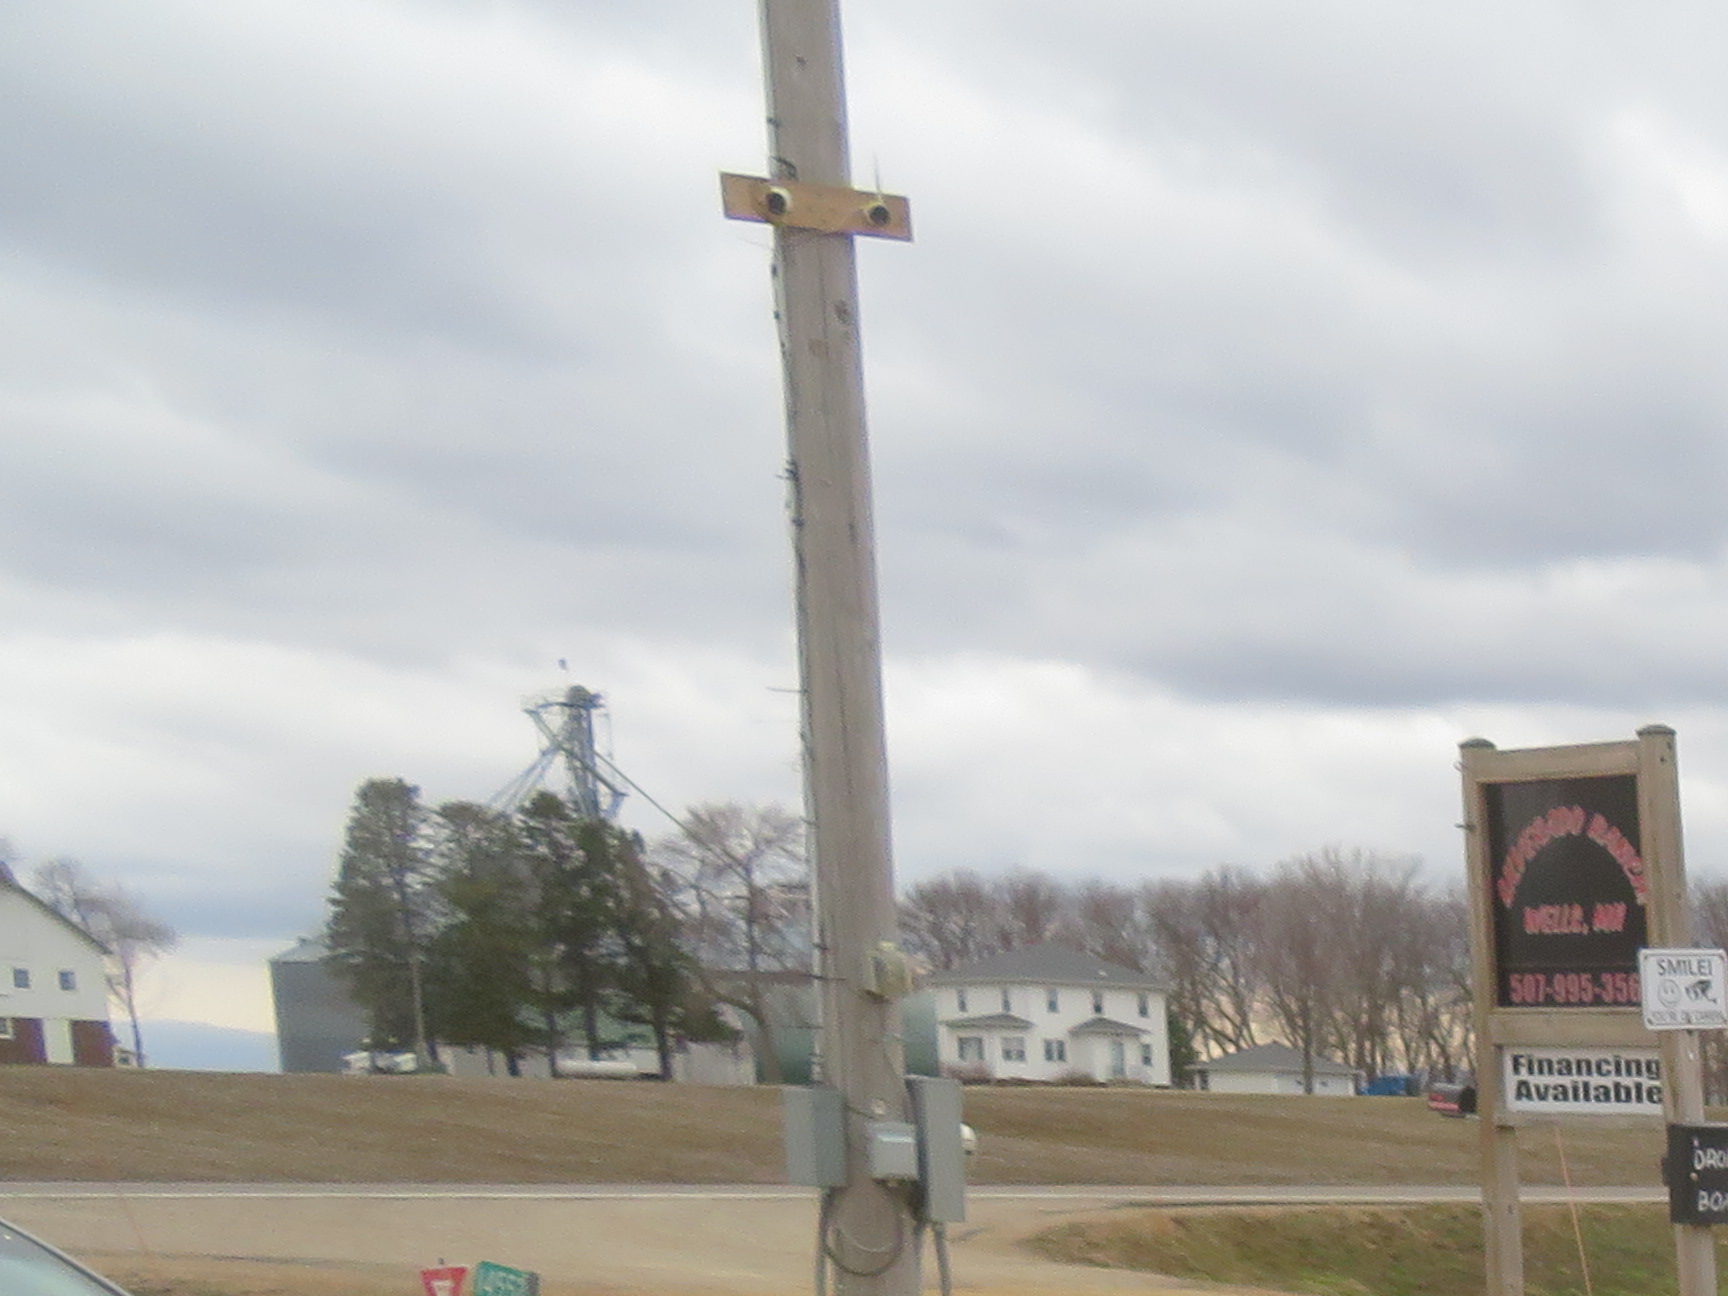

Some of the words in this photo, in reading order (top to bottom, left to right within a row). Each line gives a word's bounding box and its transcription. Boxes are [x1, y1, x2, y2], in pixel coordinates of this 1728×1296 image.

[1509, 972, 1641, 1004] 507-995-356
[1511, 1053, 1661, 1079] Financing
[1514, 1079, 1663, 1104] Available
